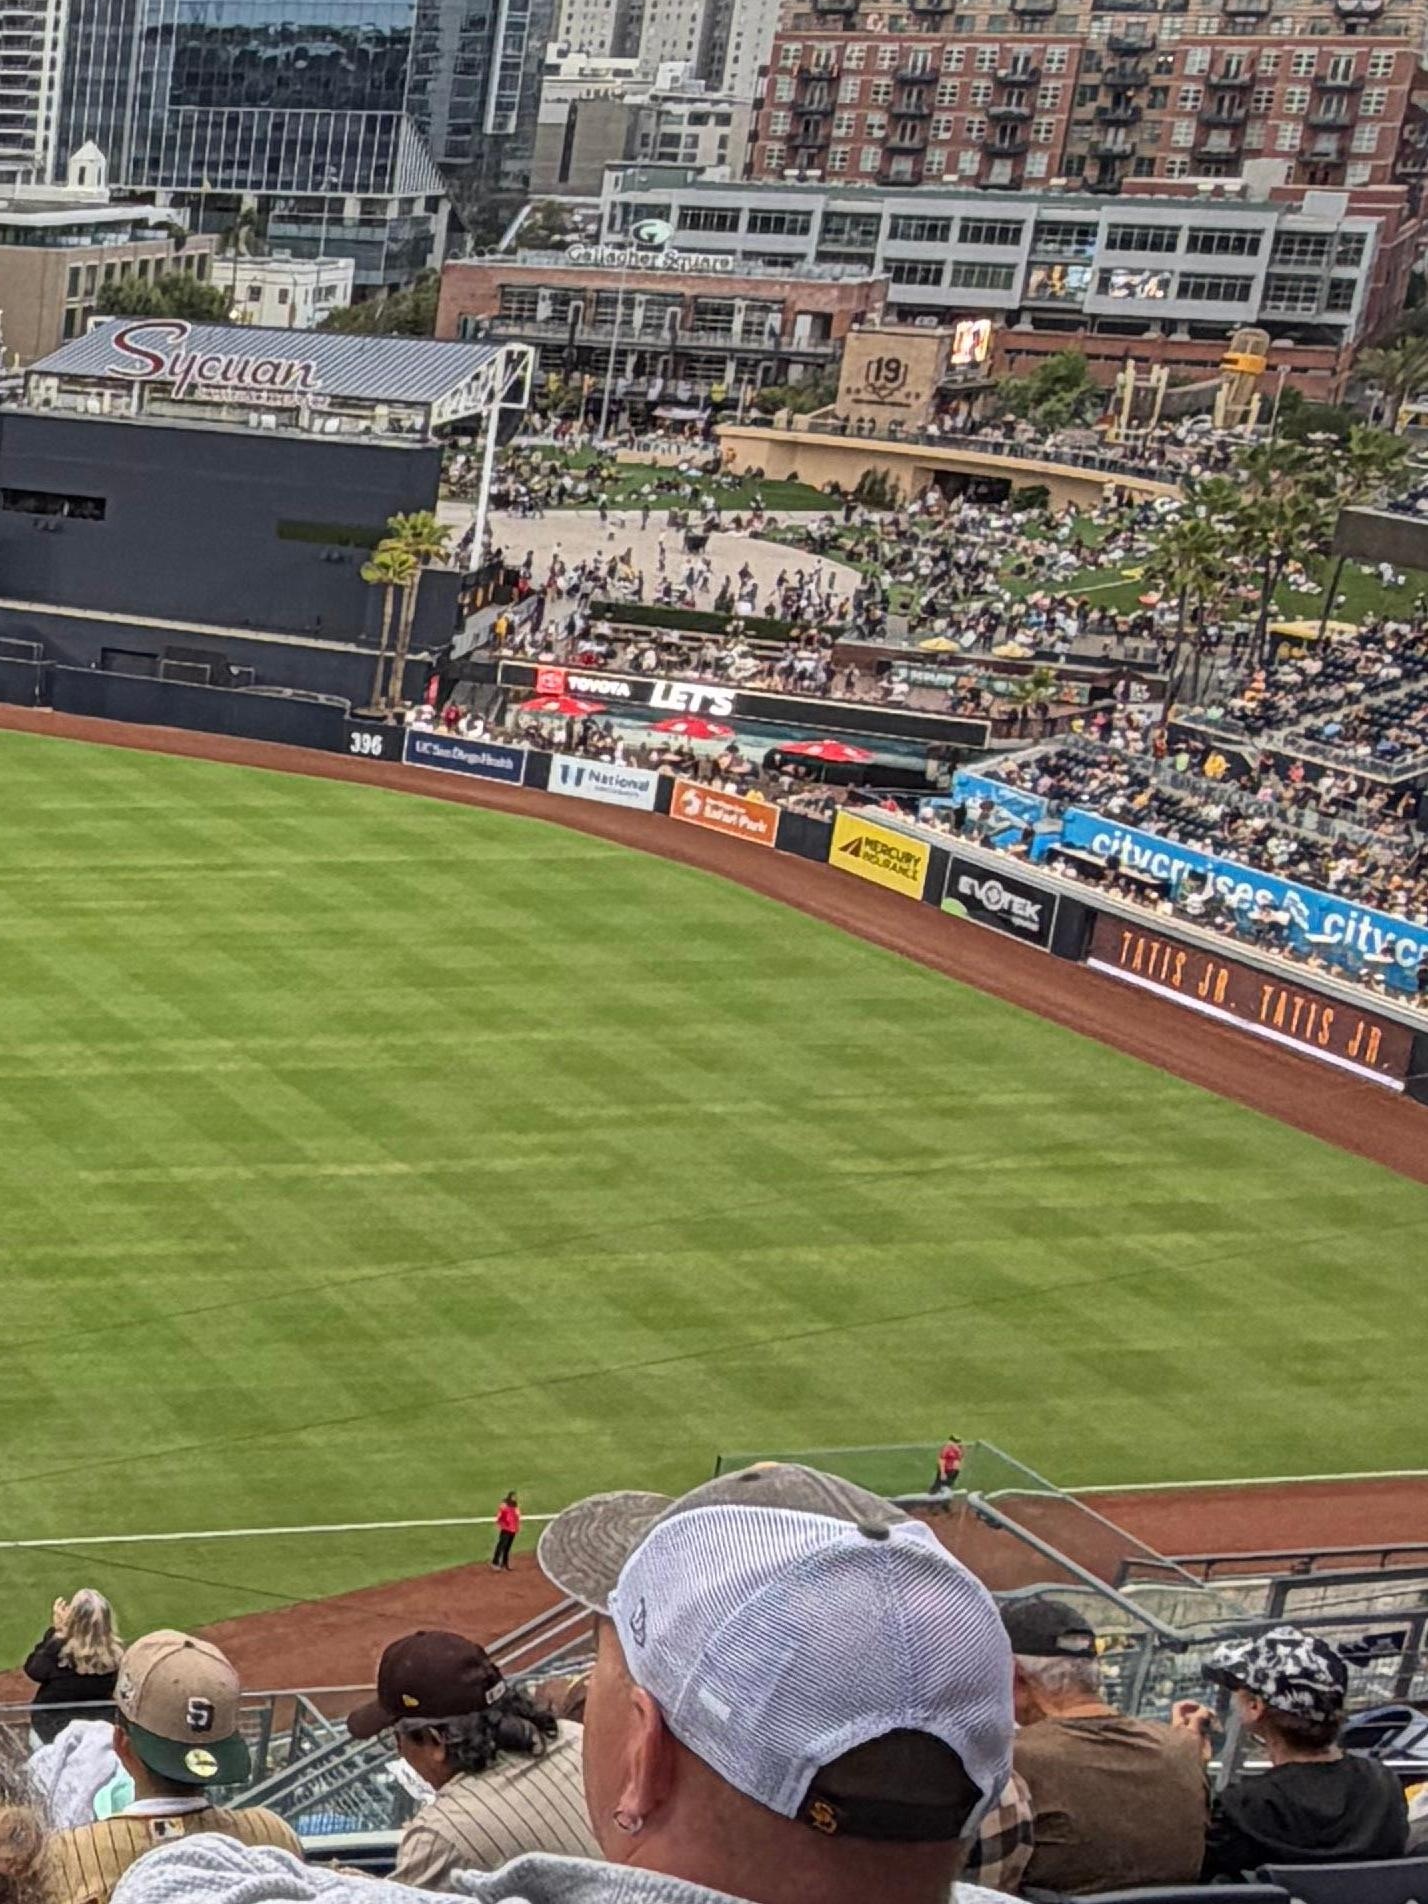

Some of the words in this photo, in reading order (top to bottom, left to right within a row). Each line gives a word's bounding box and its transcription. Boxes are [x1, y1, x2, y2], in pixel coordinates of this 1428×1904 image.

[565, 244, 658, 268] Gallagher
[663, 249, 734, 274] Square
[105, 318, 323, 400] Sycuan
[875, 356, 902, 384] 19
[567, 676, 631, 697] TOYOTA
[649, 679, 737, 717] LET'S
[349, 732, 383, 756] 396
[587, 768, 650, 793] National
[737, 812, 768, 834] Park
[862, 850, 919, 882] INSURANCE
[864, 836, 922, 867] MERCURY
[958, 874, 1043, 922] EVOTEK
[1120, 929, 1185, 988] TATIS
[1198, 961, 1236, 1009] JR.
[1259, 984, 1334, 1046] TATIS
[1348, 1021, 1390, 1070] JR.
